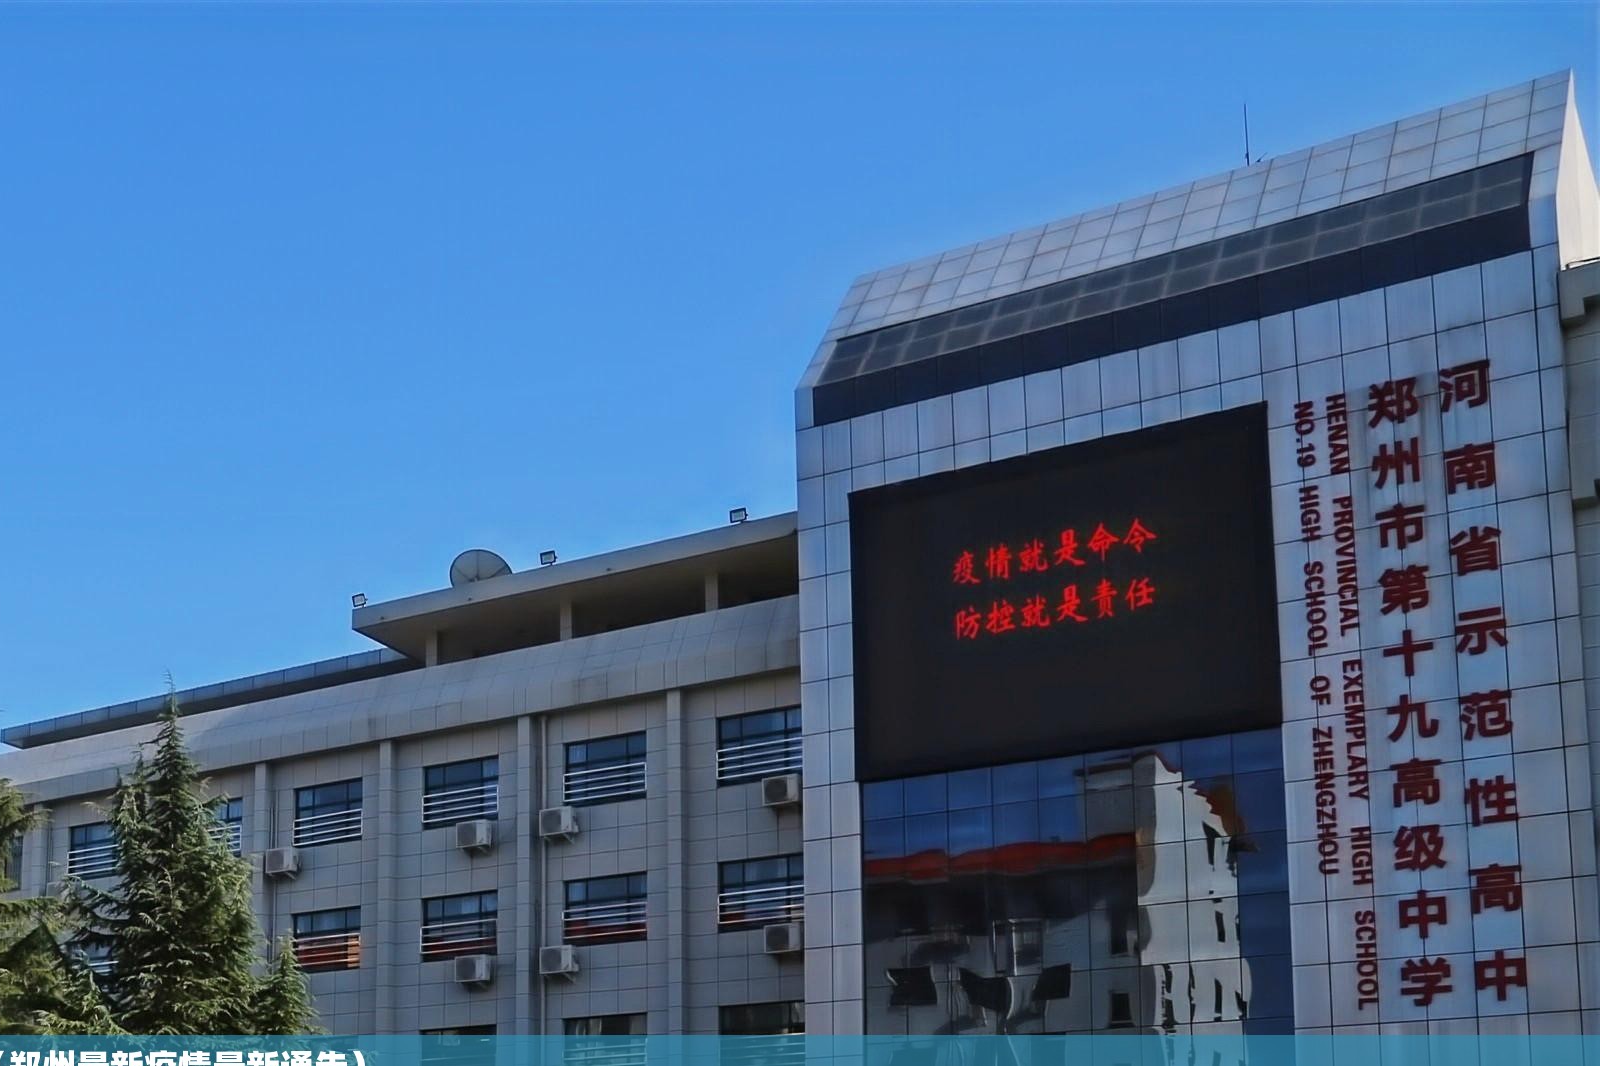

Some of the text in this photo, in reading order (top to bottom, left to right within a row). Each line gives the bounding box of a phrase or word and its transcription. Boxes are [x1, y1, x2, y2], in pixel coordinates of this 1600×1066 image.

[952, 517, 1158, 584] 疫情就是命令
[954, 577, 1156, 640] 防控就是责任
[1293, 401, 1340, 875] NO.19 HIGH SCHOOL OF ZHENGZHOU
[1325, 392, 1379, 1011] HENAN PROVINCIAL EXEMPLARY HIGH SCHOOL
[1367, 376, 1452, 1007] 郑州市第十九高级中学
[1438, 359, 1528, 1001] 河南省示范性高中
